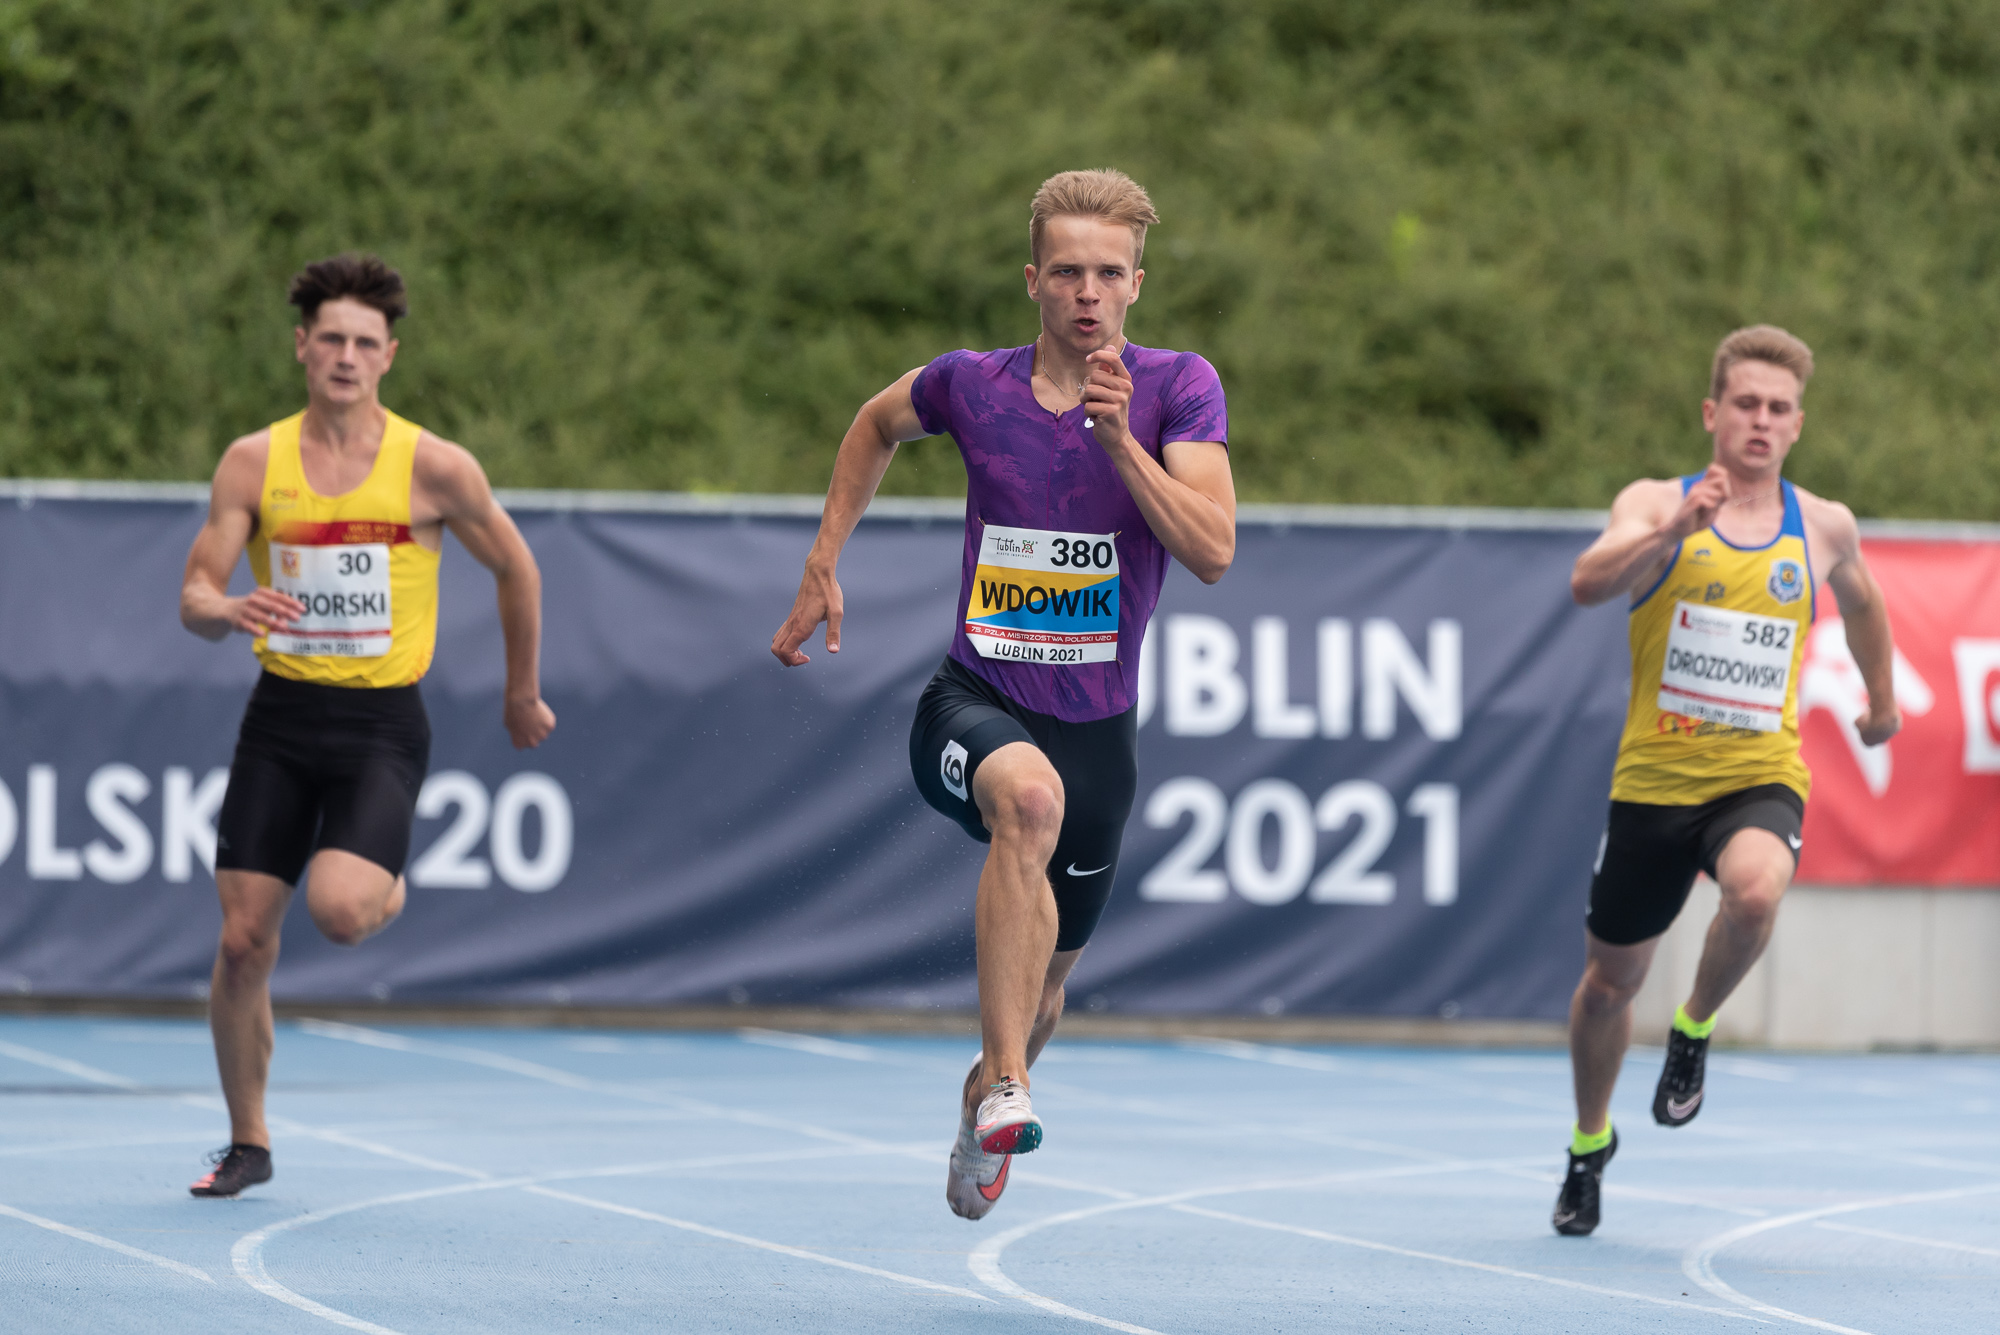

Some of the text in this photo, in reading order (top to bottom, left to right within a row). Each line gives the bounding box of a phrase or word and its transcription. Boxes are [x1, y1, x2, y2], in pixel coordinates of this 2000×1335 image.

[338, 552, 372, 576] 30
[1050, 538, 1113, 569] 380
[276, 587, 385, 617] BORSKI
[980, 580, 1113, 617] WDOWIK
[971, 625, 983, 634] 75.
[984, 628, 1006, 638] PZLA
[1007, 631, 1064, 643] MISTRZOSTWA
[1065, 635, 1093, 643] POLSKI
[1742, 621, 1791, 650] 582
[994, 642, 1083, 661] LUBLIN 2021
[1667, 646, 1786, 691] DROZDOWSKI
[943, 754, 964, 789] 6
[0, 763, 230, 884] LSK
[1137, 775, 1463, 907] 2021
